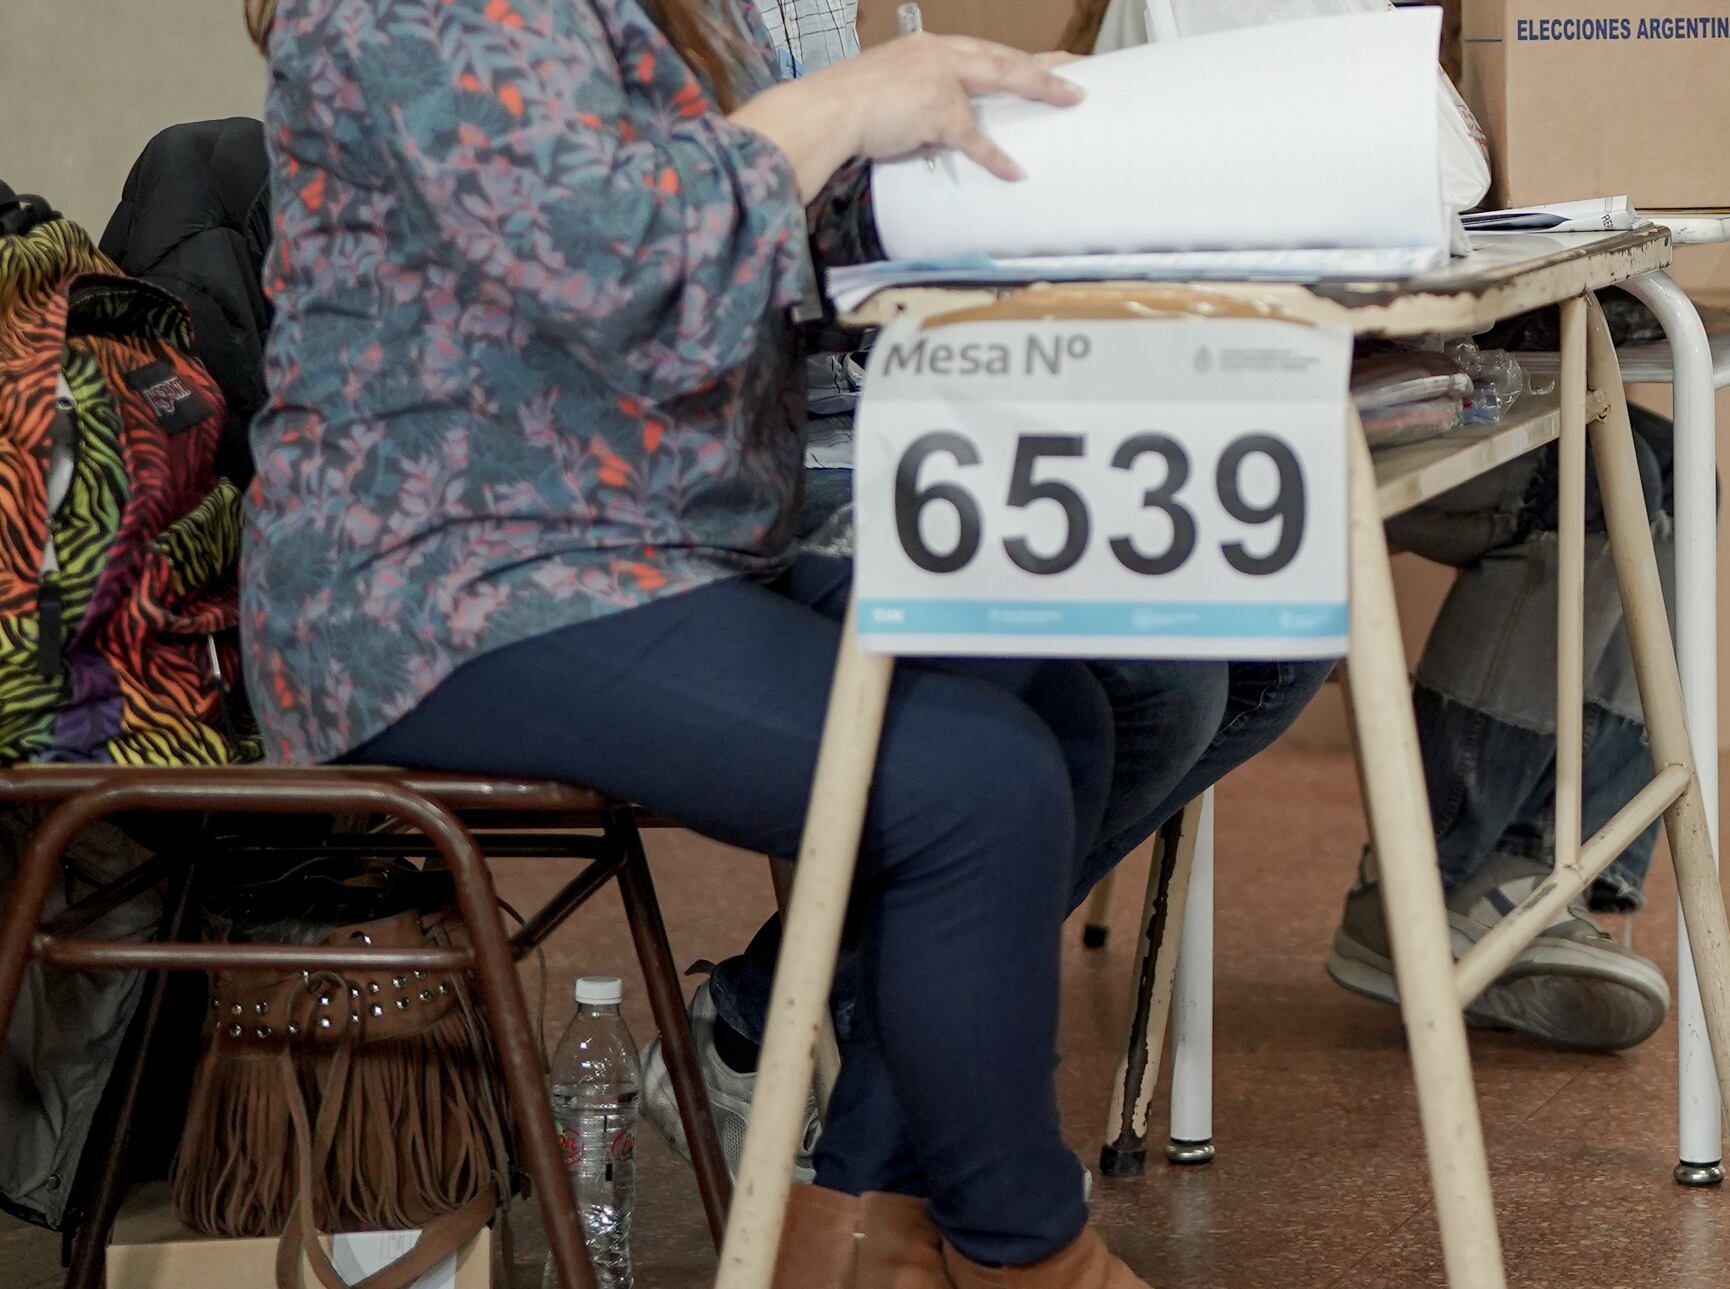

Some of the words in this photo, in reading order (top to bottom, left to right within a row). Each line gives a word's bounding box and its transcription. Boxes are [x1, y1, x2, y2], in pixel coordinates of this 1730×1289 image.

[1516, 18, 1631, 41] ELECCIONES
[883, 336, 1012, 378] Mesa
[894, 428, 1308, 577] 6539
